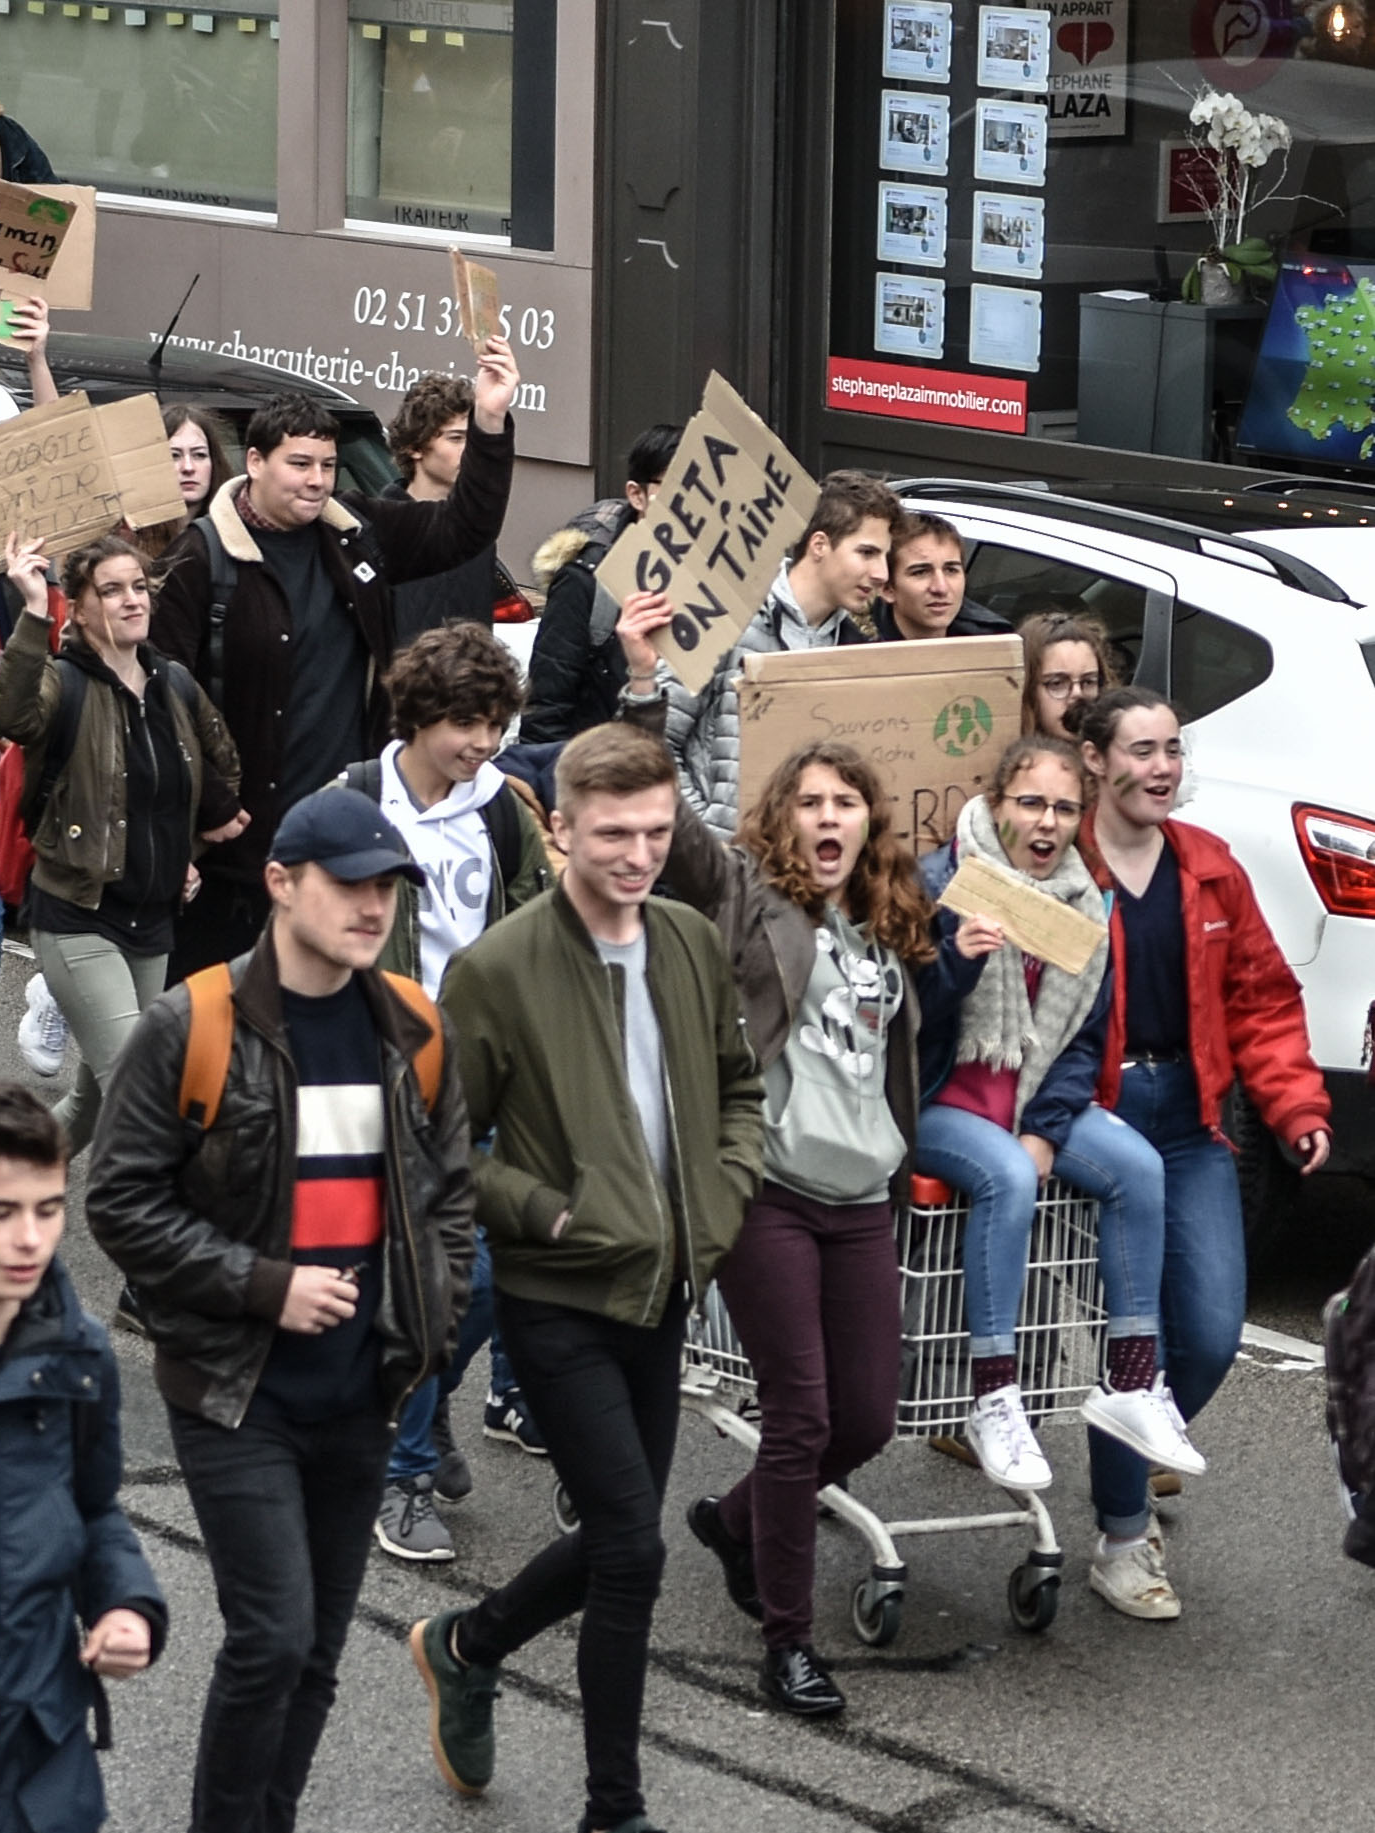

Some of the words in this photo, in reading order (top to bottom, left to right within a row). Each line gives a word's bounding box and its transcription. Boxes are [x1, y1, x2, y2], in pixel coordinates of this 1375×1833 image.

[1061, 1, 1113, 16] APPART
[1048, 74, 1112, 90] TEPHANE
[394, 205, 469, 230] TRAITEUR
[354, 286, 387, 326] 02
[394, 292, 425, 331] 51
[520, 307, 555, 350] 03
[831, 375, 1023, 417] stephaneplazaimmobilier.com
[635, 434, 740, 595] GRETA
[671, 582, 729, 652] ON
[809, 702, 911, 738] Sauvons
